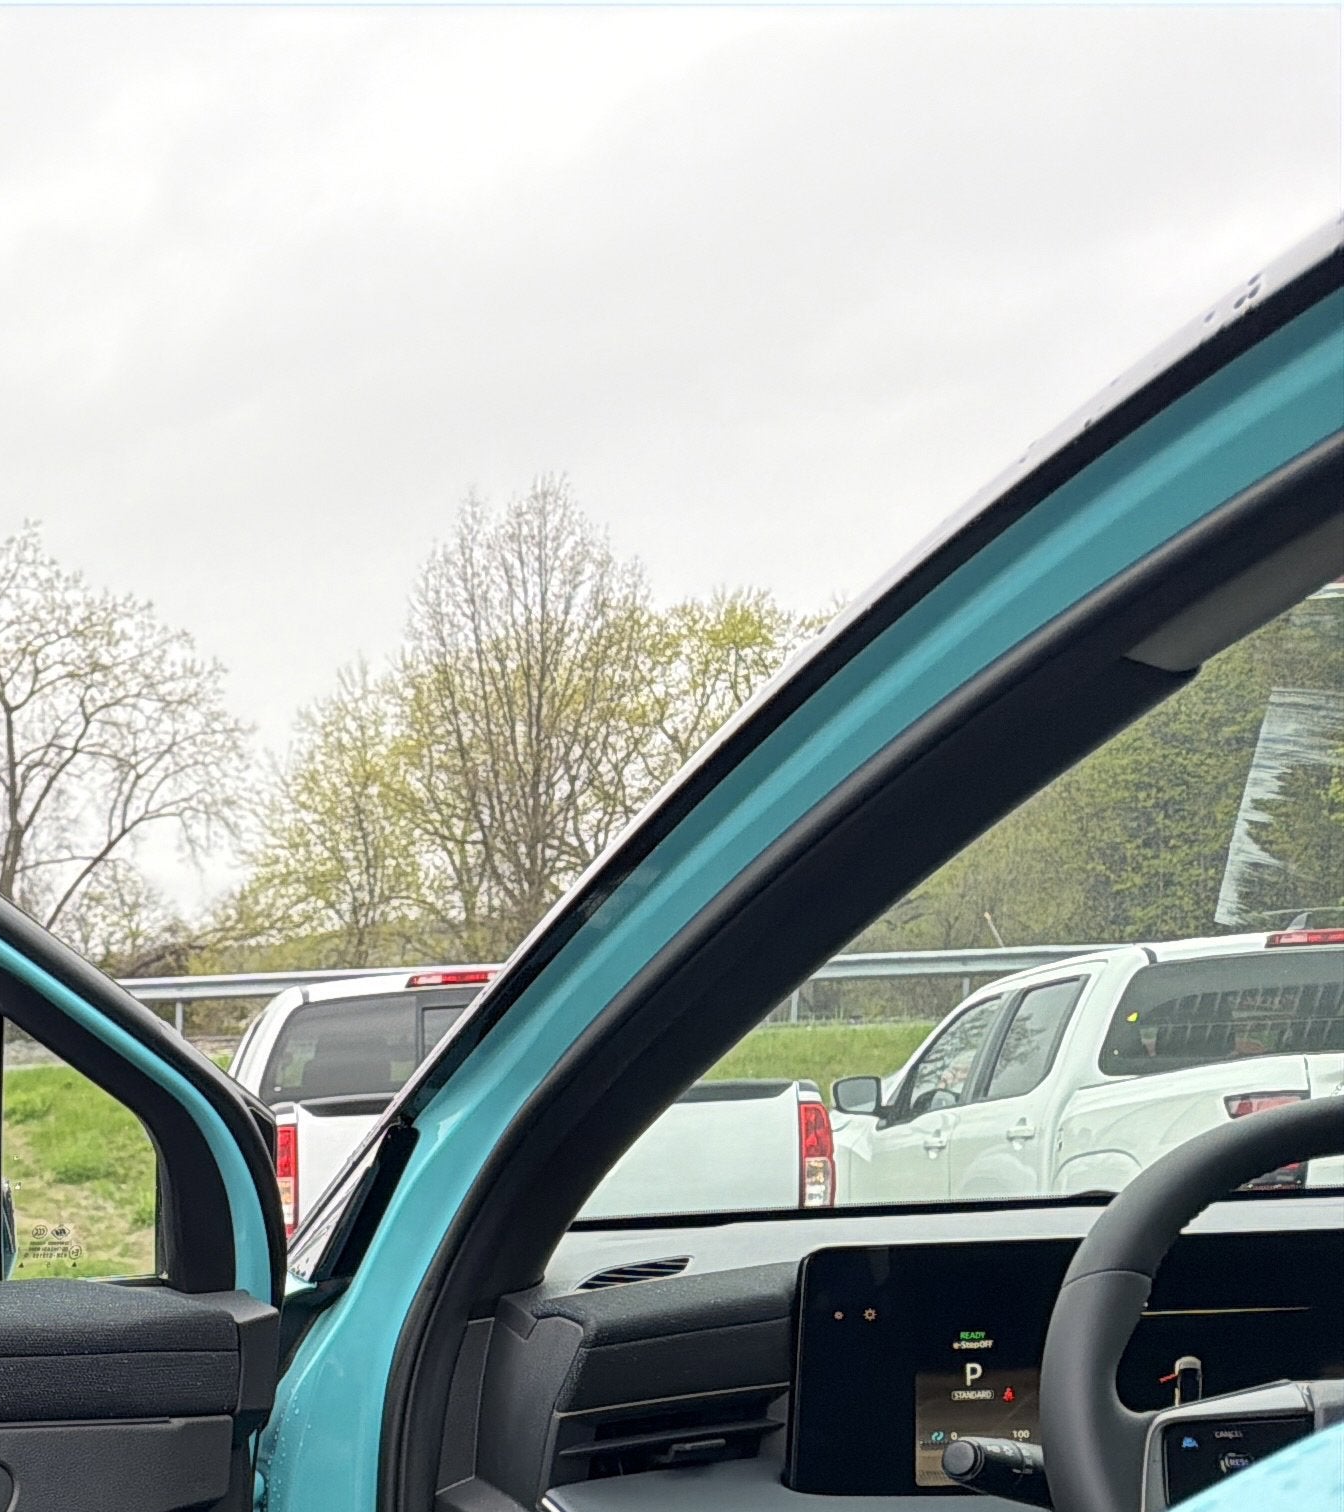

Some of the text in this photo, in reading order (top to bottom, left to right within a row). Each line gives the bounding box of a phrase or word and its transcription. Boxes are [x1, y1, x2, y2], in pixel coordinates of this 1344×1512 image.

[959, 1331, 986, 1340] READY
[965, 1362, 983, 1387] P
[954, 1391, 992, 1399] STANDARD
[951, 1432, 958, 1440] 0
[1012, 1430, 1031, 1438] 100
